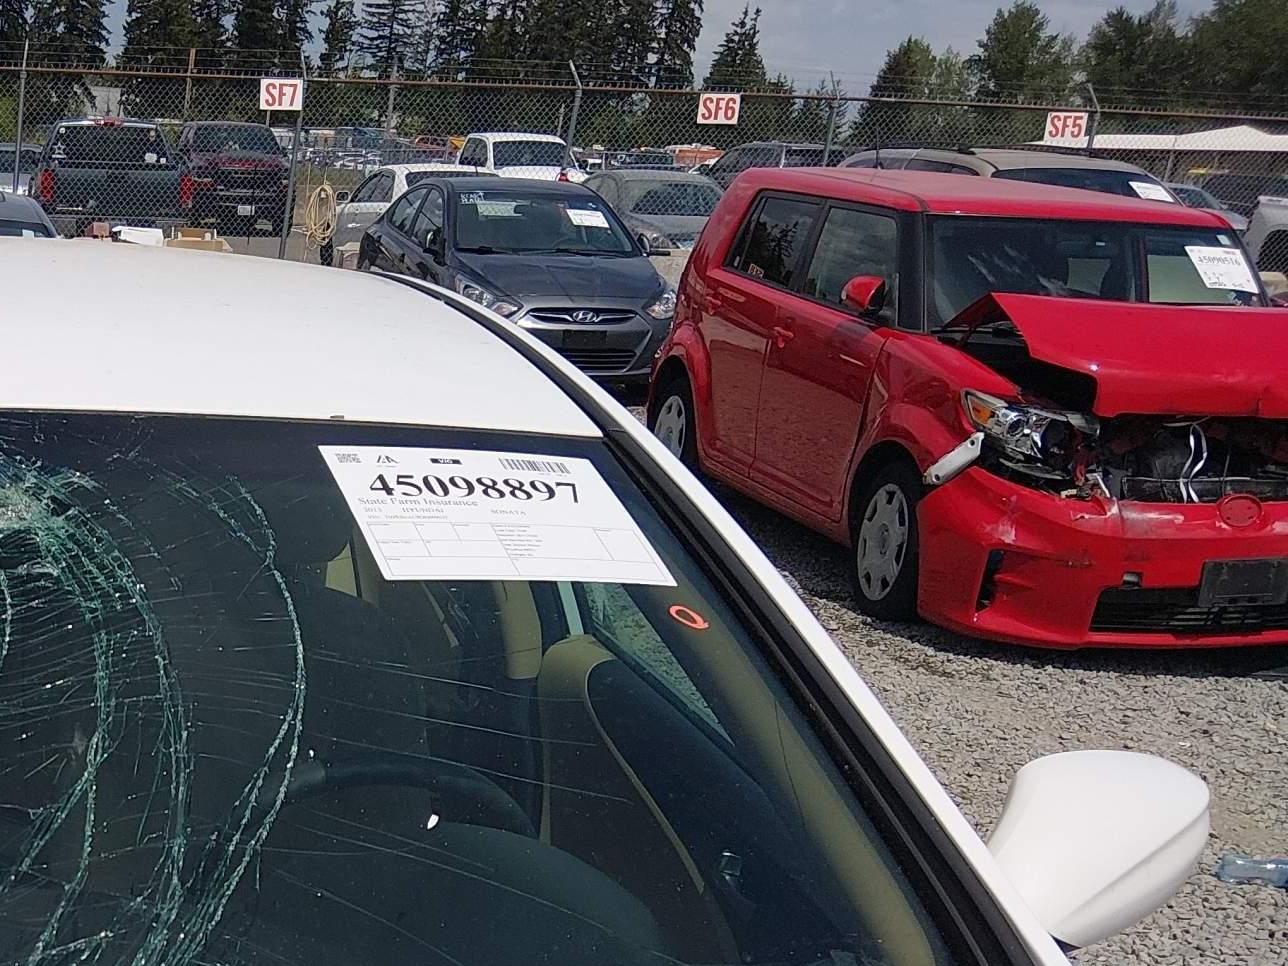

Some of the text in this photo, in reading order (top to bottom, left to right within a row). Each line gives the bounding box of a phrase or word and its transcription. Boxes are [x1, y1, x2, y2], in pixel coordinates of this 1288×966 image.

[264, 82, 298, 107] SF7
[701, 96, 737, 121] SF6
[1048, 114, 1084, 138] SF5
[369, 473, 579, 504] 45098897
[358, 497, 388, 505] State
[423, 498, 479, 507] Insurance
